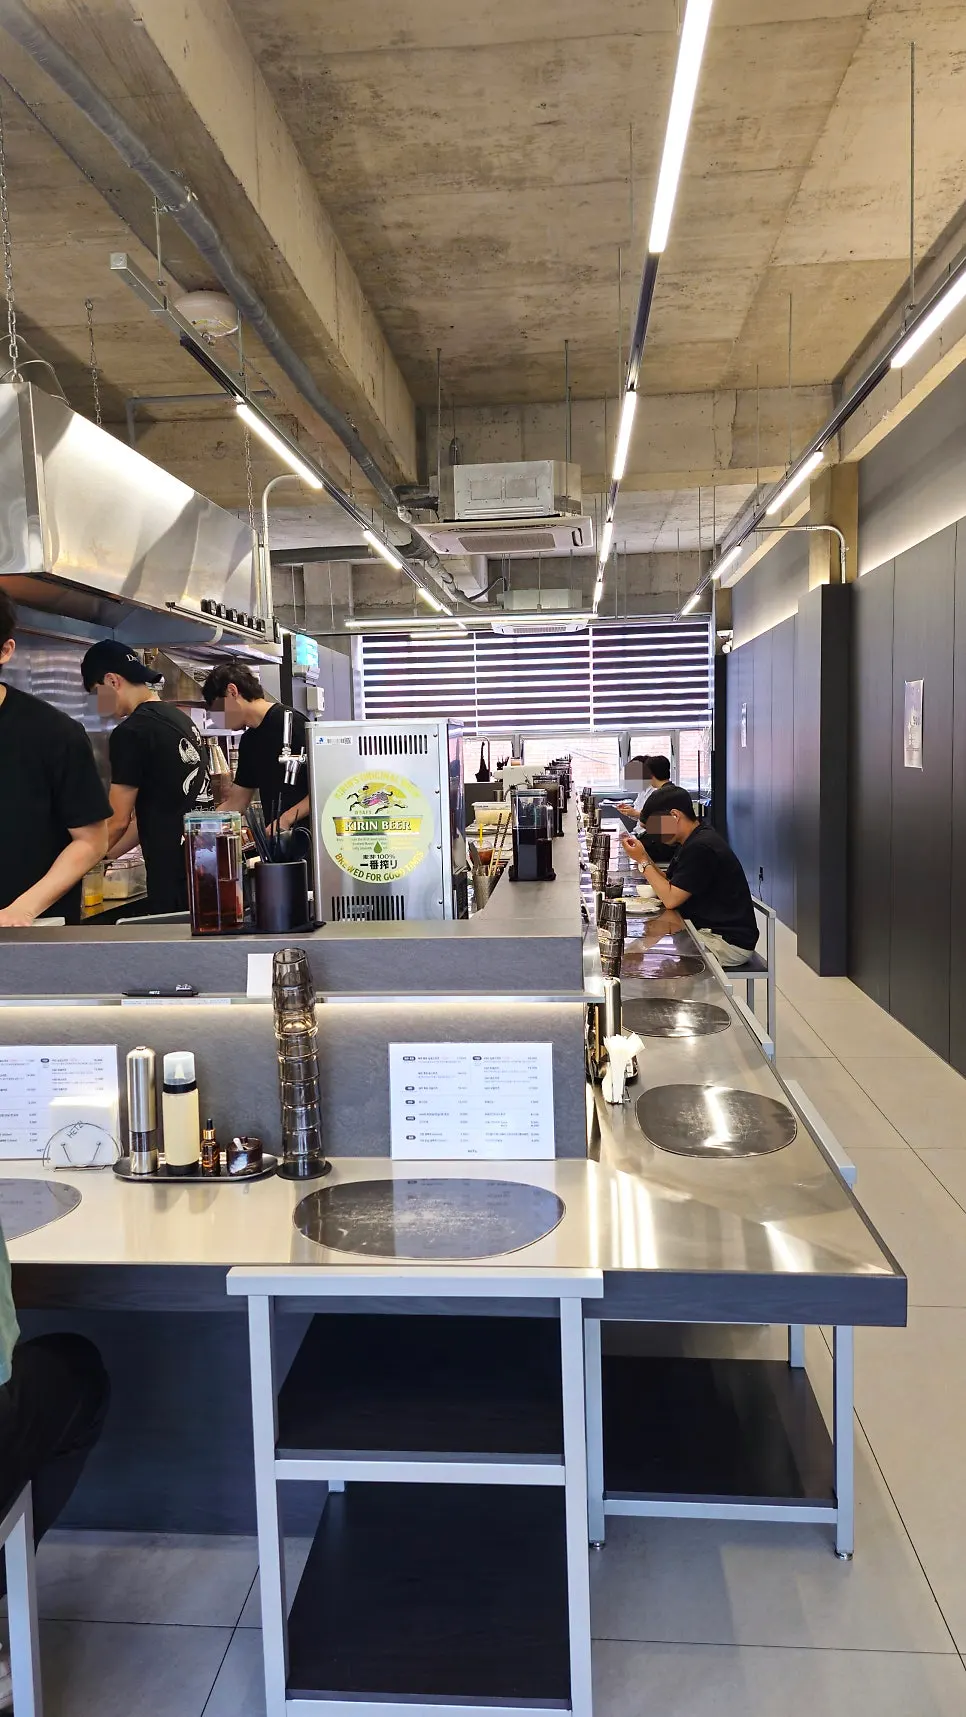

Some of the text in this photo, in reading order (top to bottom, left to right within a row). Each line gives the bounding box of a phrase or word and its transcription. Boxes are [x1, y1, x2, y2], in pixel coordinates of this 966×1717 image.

[344, 820, 412, 832] KIRIN BEER
[360, 859, 398, 870] 一番搾り
[365, 872, 382, 882] FOR
